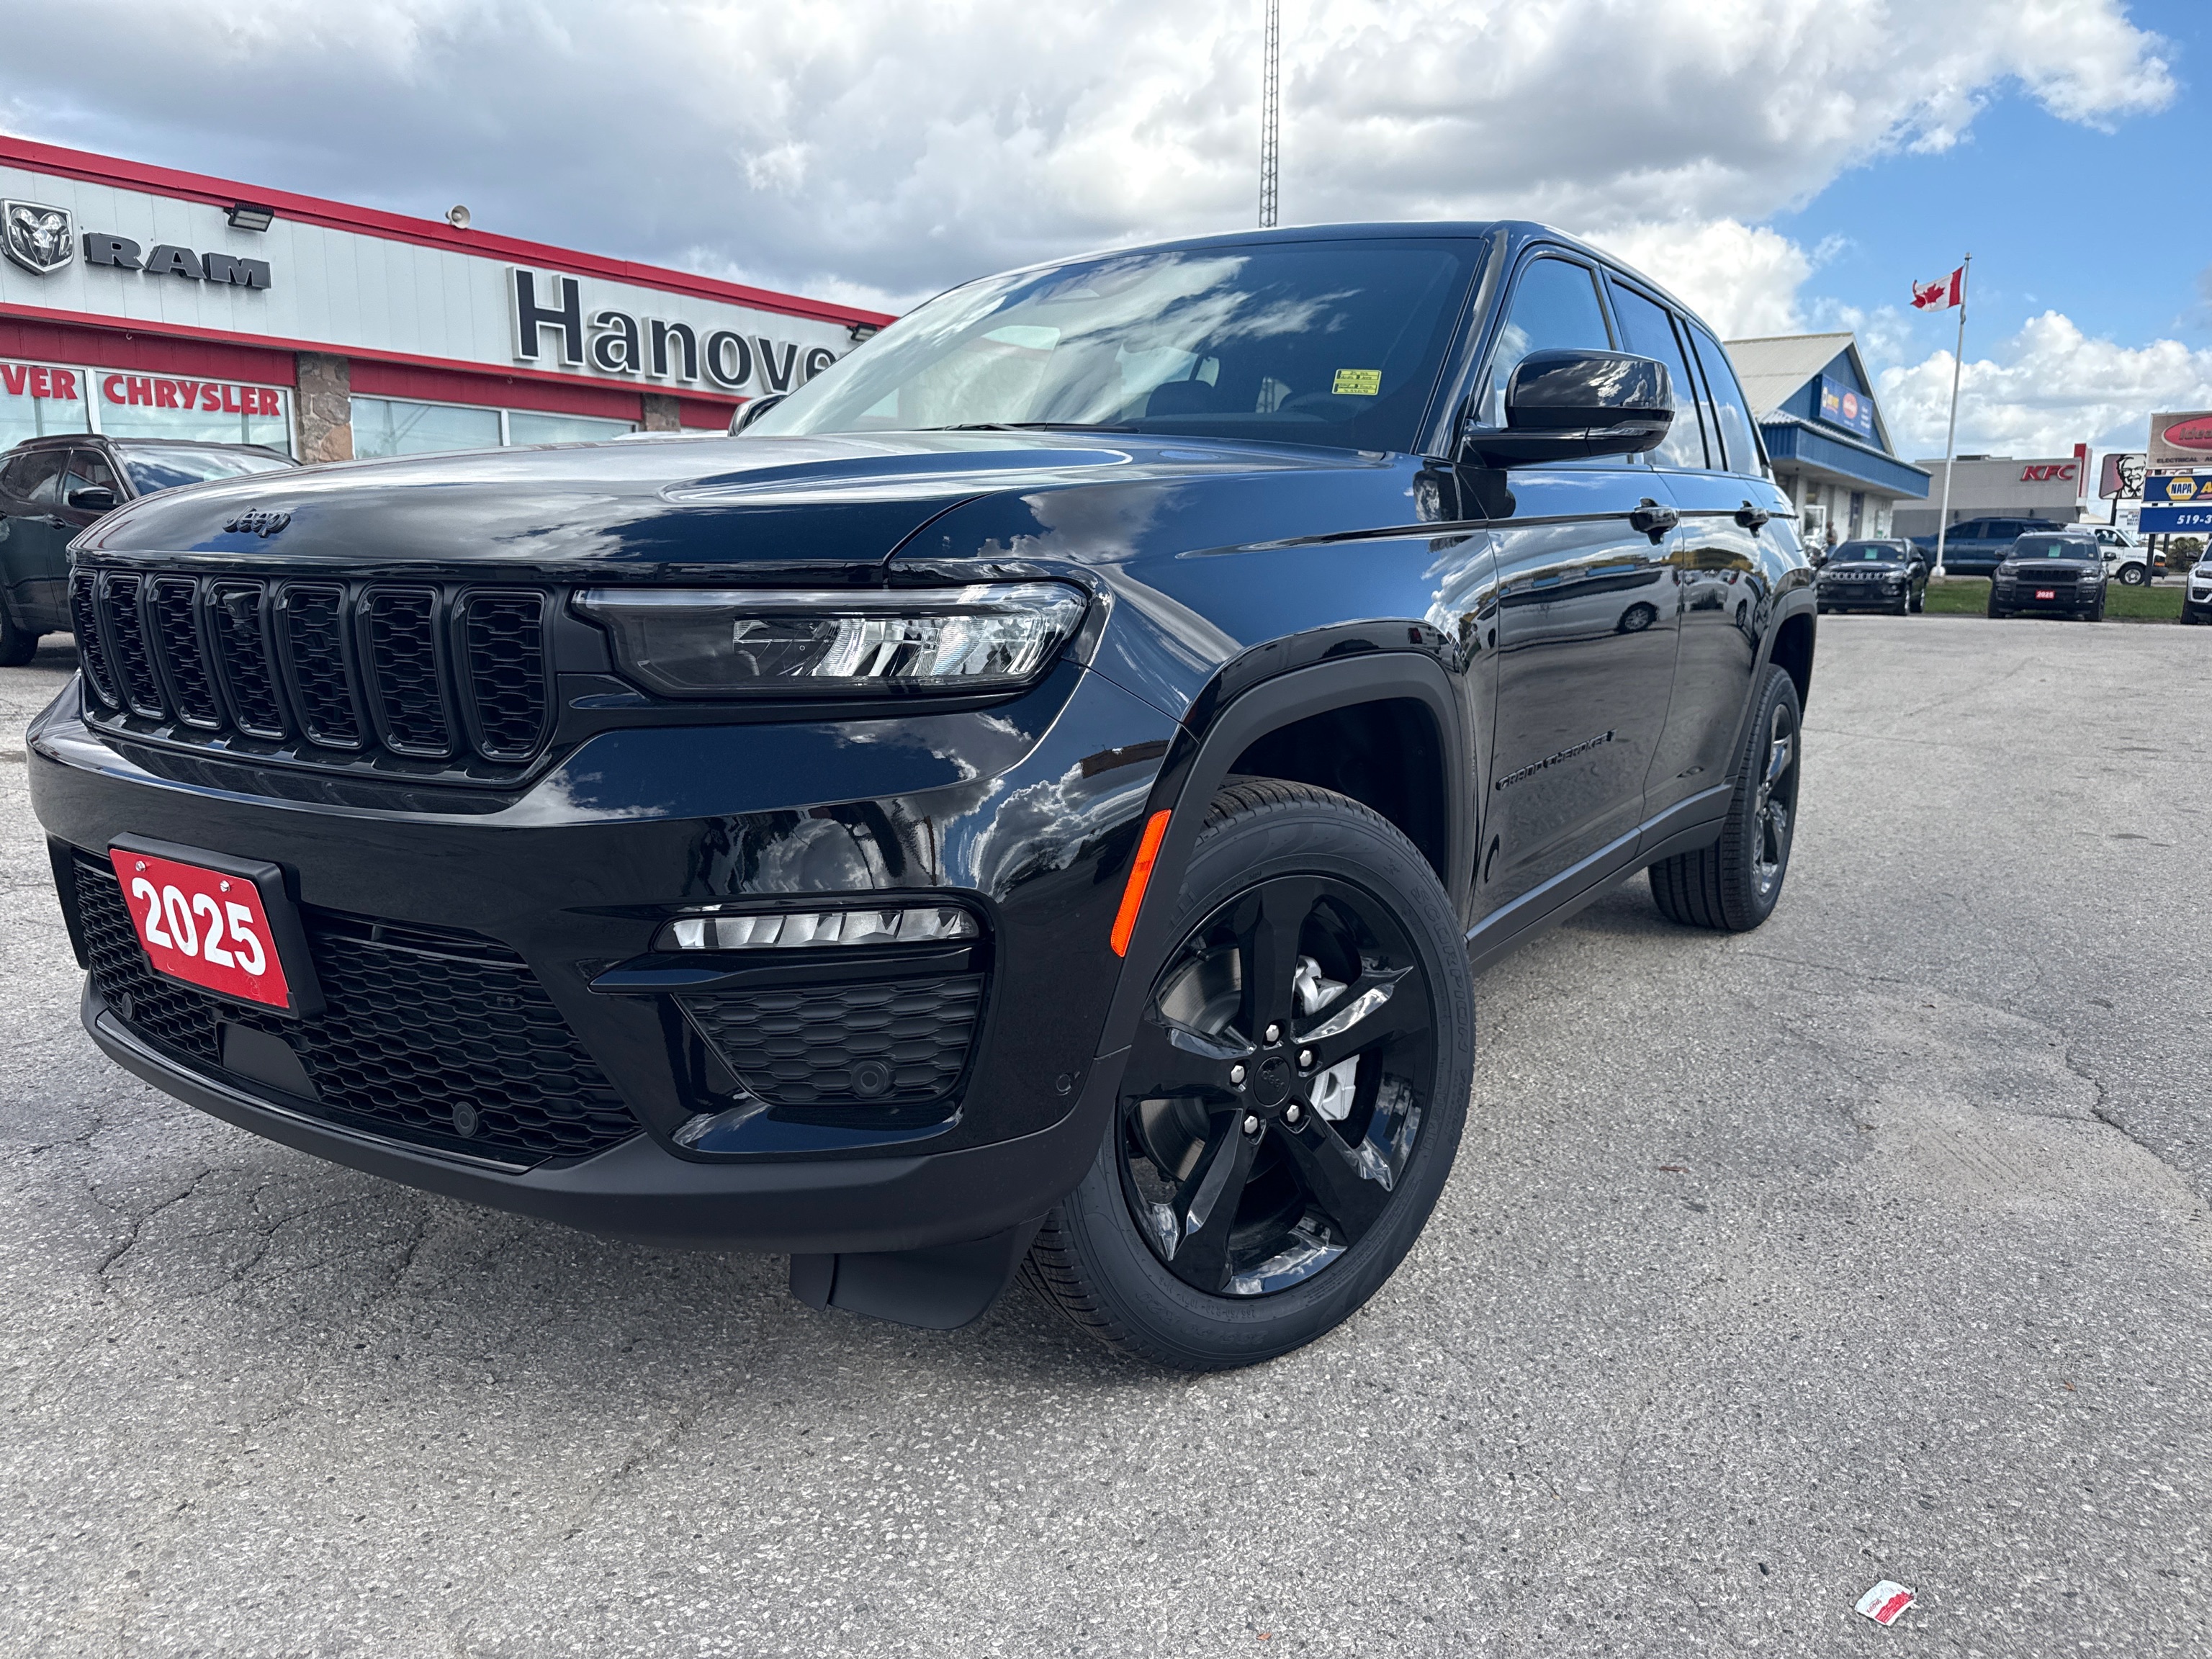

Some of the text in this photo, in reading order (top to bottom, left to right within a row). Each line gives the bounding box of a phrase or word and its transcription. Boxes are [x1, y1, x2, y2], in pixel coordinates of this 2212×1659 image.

[84, 232, 272, 289] RAM
[506, 265, 840, 395] Hanove
[102, 374, 281, 416] CHRYSLER
[2020, 464, 2077, 482] KFC
[2171, 483, 2192, 494] NAPA
[222, 505, 291, 538] Jeep
[132, 877, 266, 976] 2025
